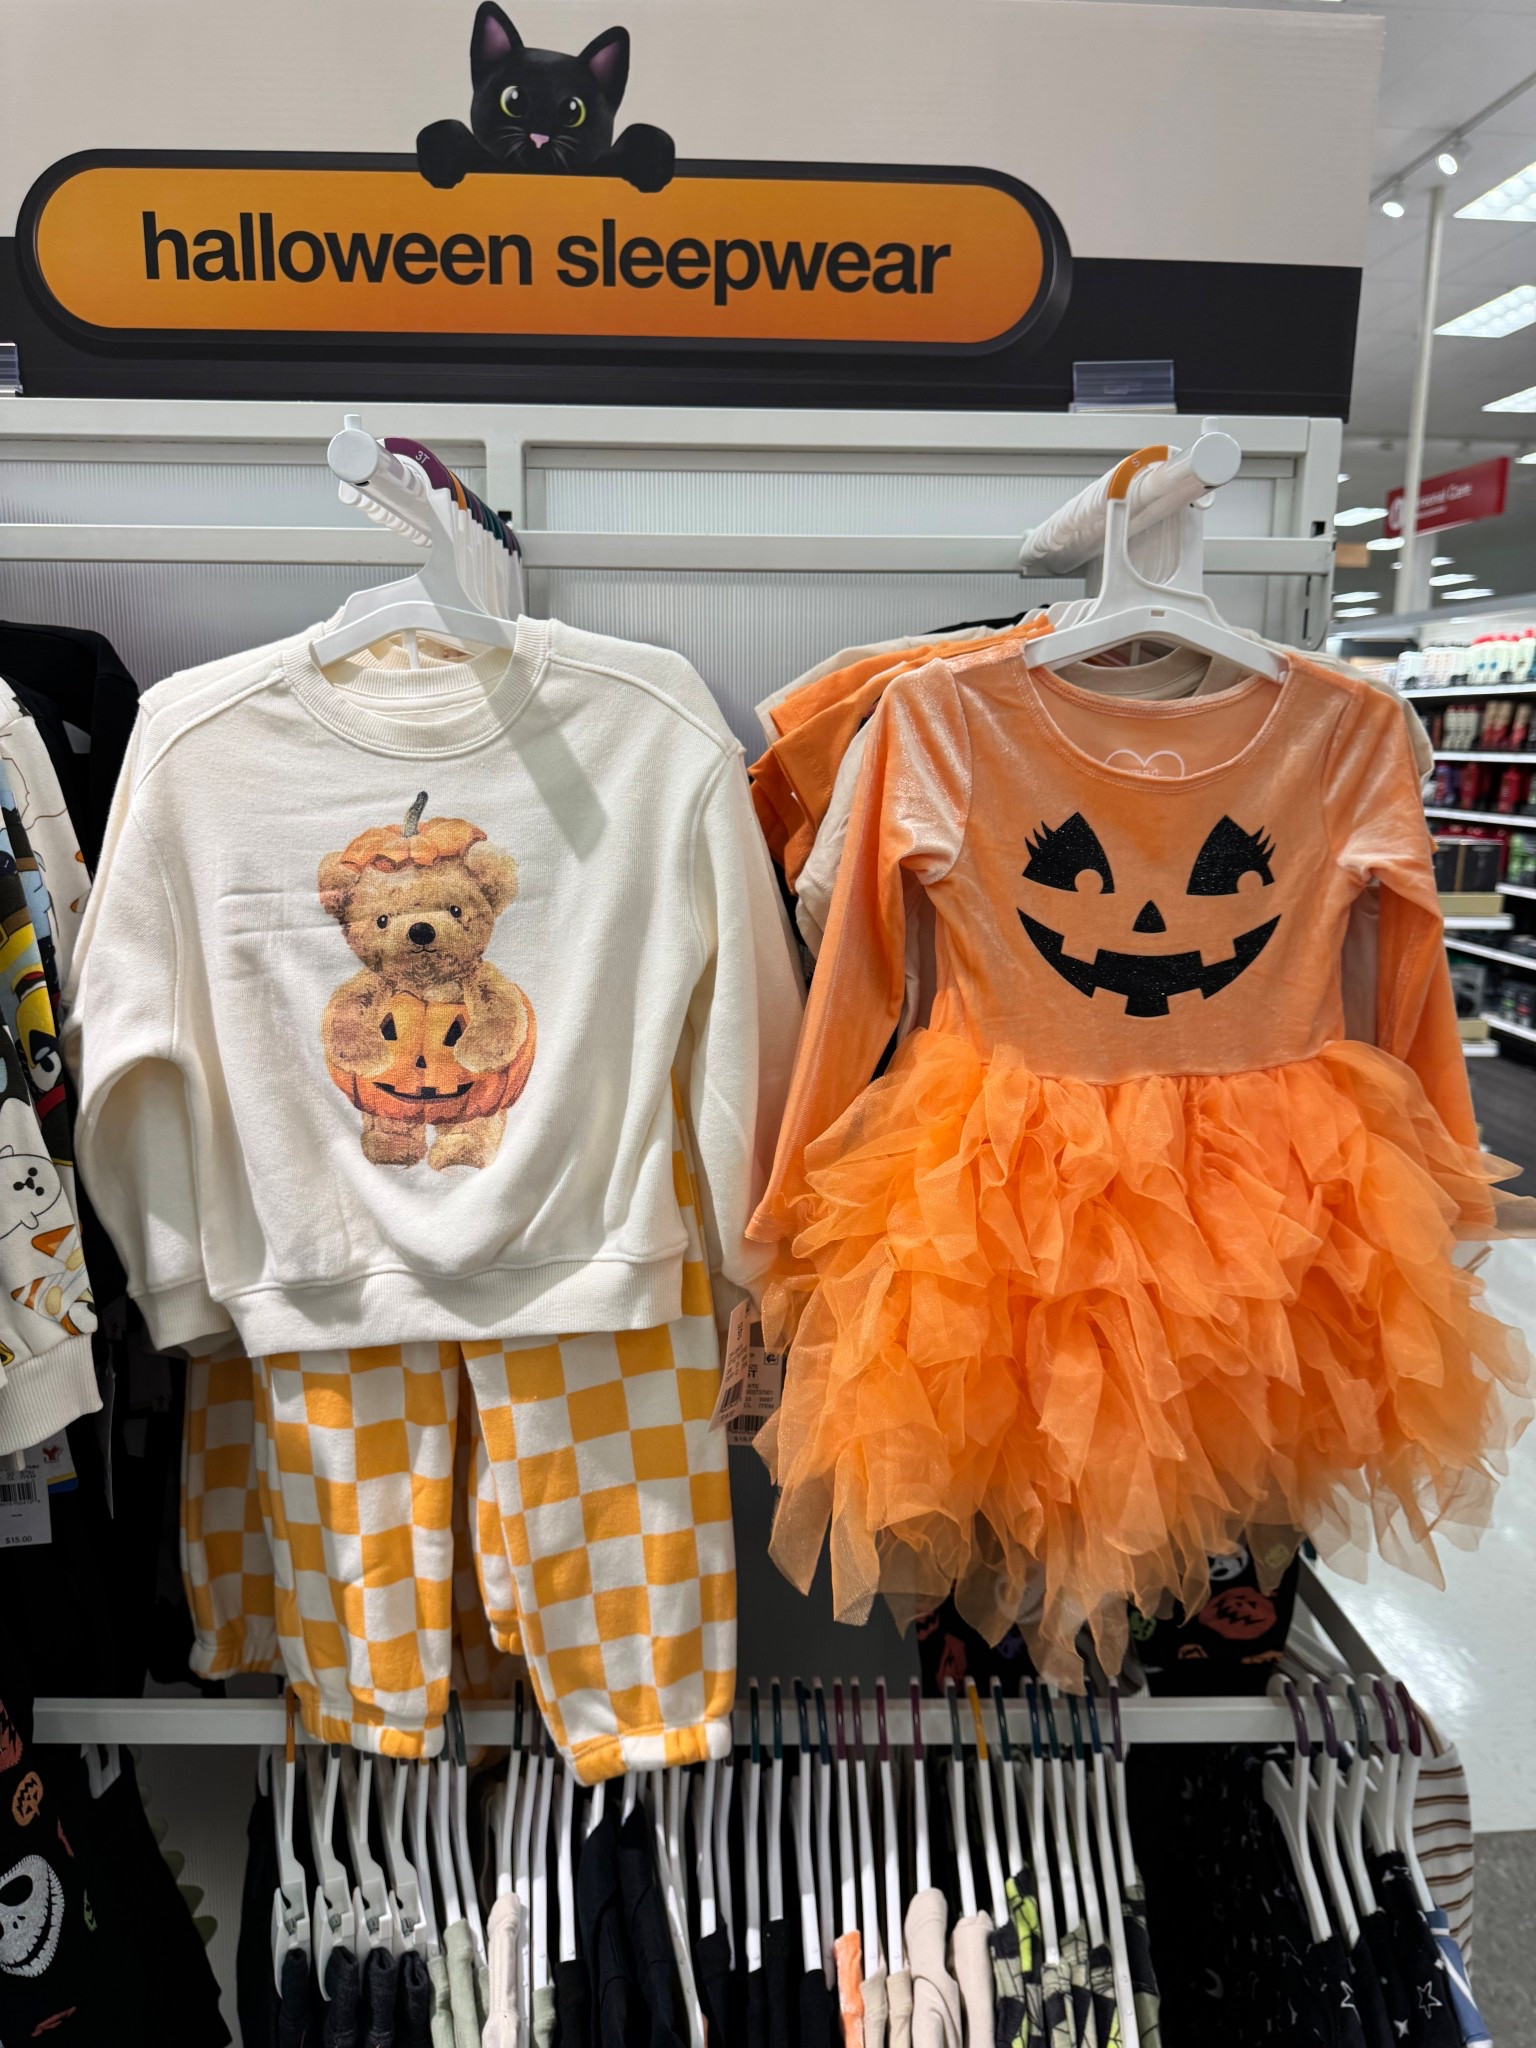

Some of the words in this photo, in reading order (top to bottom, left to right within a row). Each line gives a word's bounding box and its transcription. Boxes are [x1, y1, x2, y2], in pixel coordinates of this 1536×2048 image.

[143, 210, 533, 285] halloween
[557, 218, 952, 307] sleepwear
[414, 450, 430, 464] 3T
[1131, 457, 1140, 467] S
